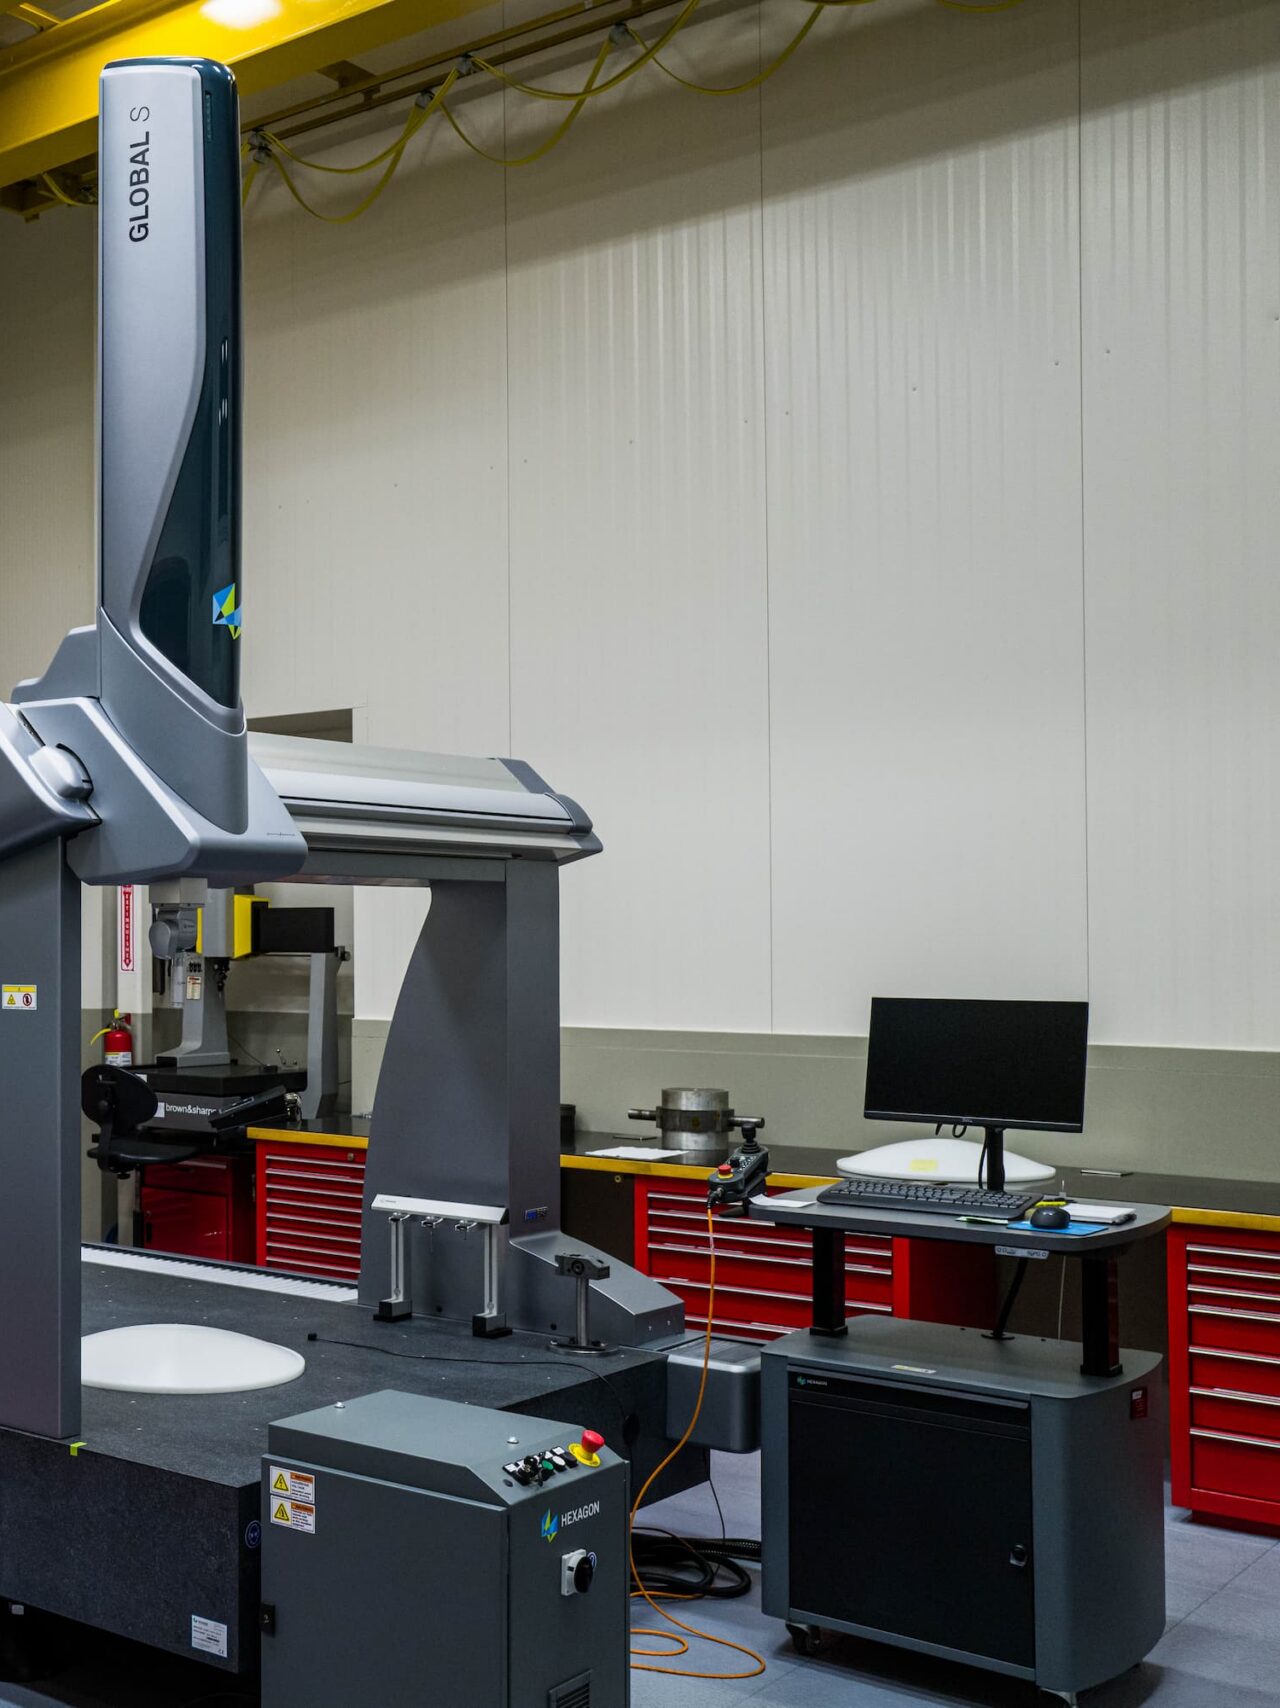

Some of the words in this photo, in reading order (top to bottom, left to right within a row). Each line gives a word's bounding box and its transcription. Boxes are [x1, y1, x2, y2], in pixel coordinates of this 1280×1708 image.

[129, 106, 150, 122] S
[129, 131, 149, 242] GLOBAL
[561, 1501, 600, 1528] HEXAGON
